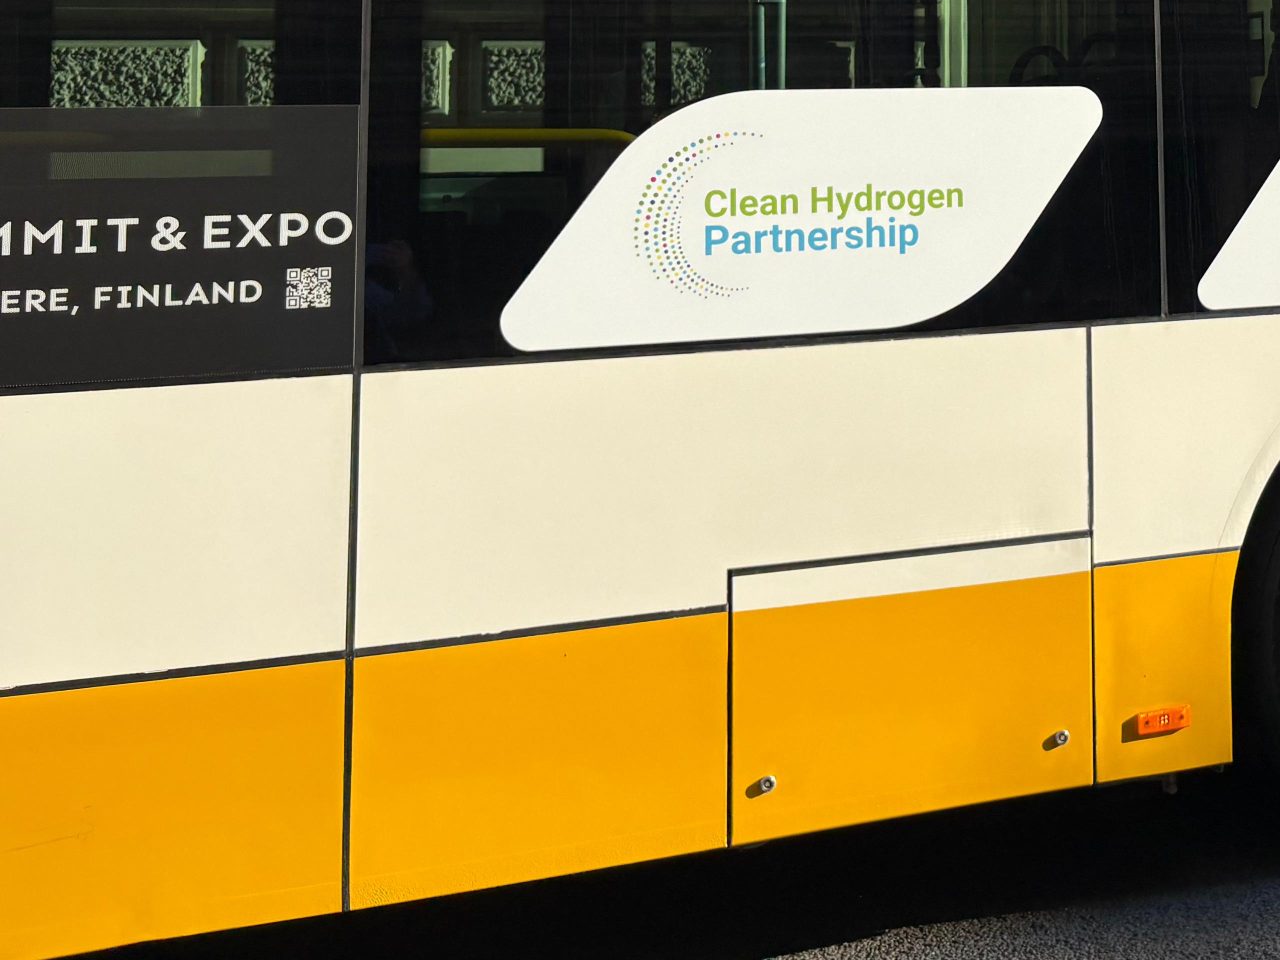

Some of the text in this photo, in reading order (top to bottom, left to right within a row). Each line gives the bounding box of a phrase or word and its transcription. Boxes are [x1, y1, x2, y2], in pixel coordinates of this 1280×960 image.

[704, 184, 964, 220] Clean Hydrogen
[150, 215, 188, 252] &
[203, 210, 354, 249] EXPO
[704, 217, 920, 256] Partnership
[0, 280, 263, 316] ERE, FINLAND
